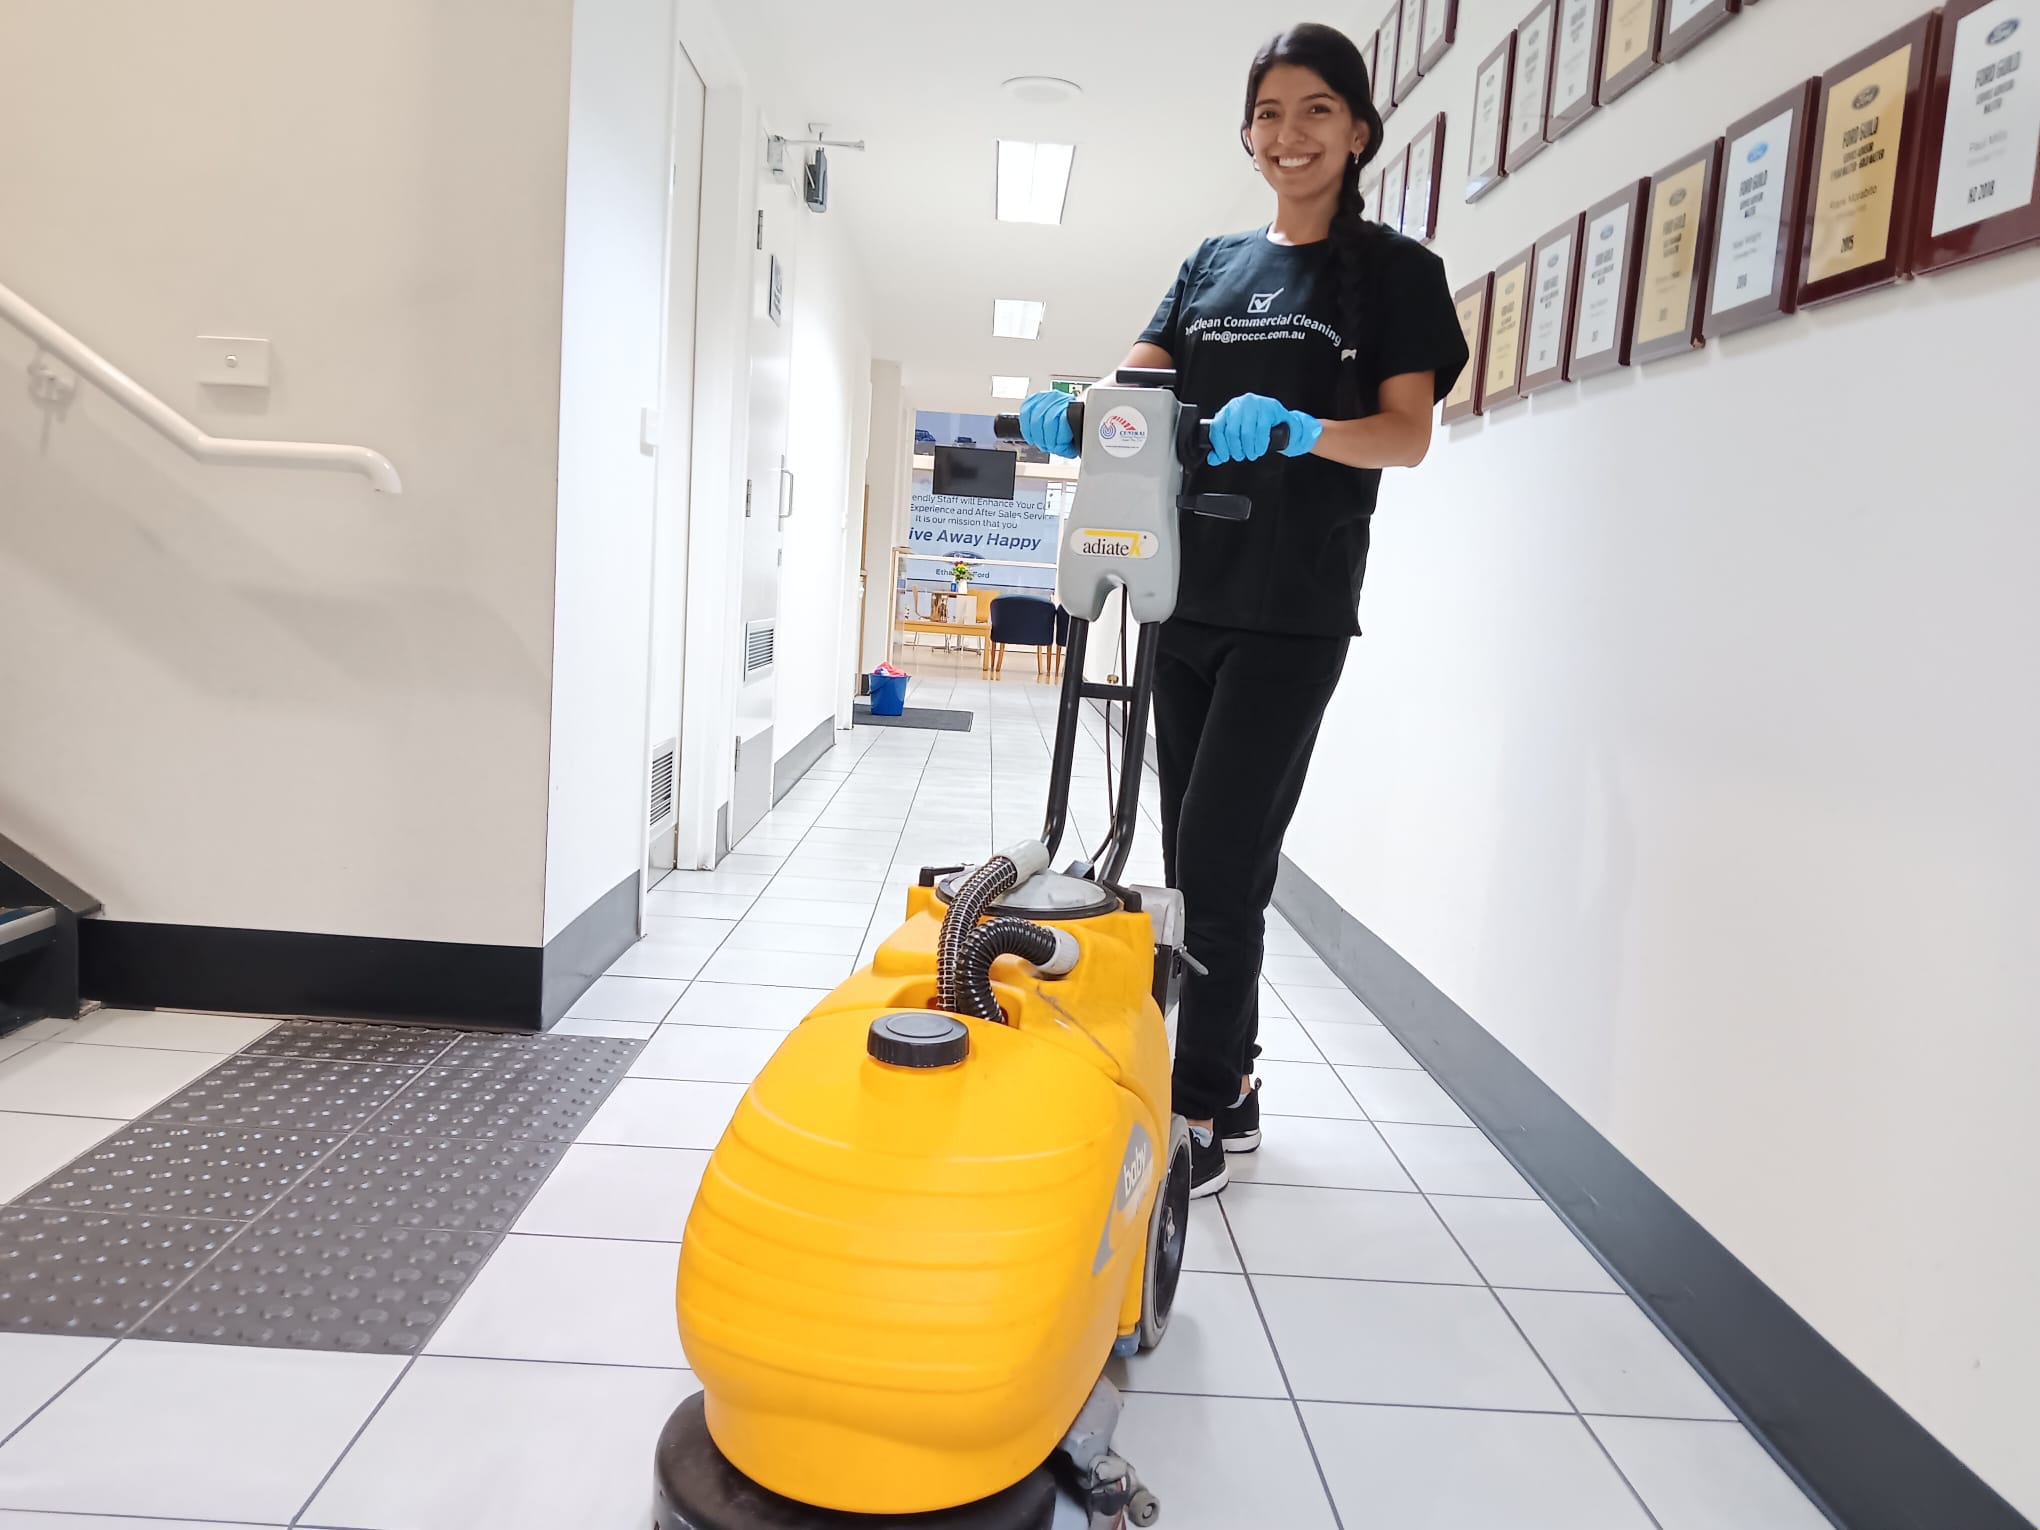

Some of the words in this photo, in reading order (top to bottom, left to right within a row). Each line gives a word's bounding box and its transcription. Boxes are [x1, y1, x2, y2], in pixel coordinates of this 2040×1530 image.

[1202, 331, 1305, 343] info@proccc.com.au
[1223, 314, 1292, 328] Commercial
[1293, 314, 1342, 347] Cleaning
[937, 495, 959, 504] Staff
[960, 497, 975, 505] will
[1016, 500, 1035, 509] Your
[910, 503, 956, 515] Experience
[956, 507, 974, 515] and
[975, 508, 996, 517] After
[998, 509, 1022, 519] Sales
[915, 514, 922, 523] It
[923, 515, 931, 523] is
[932, 516, 945, 524] our
[948, 517, 981, 526] mission
[982, 519, 1000, 528] that
[1002, 521, 1018, 530] you
[936, 529, 983, 547] Away
[986, 532, 1042, 551] Happy
[1123, 1142, 1147, 1197] baby
